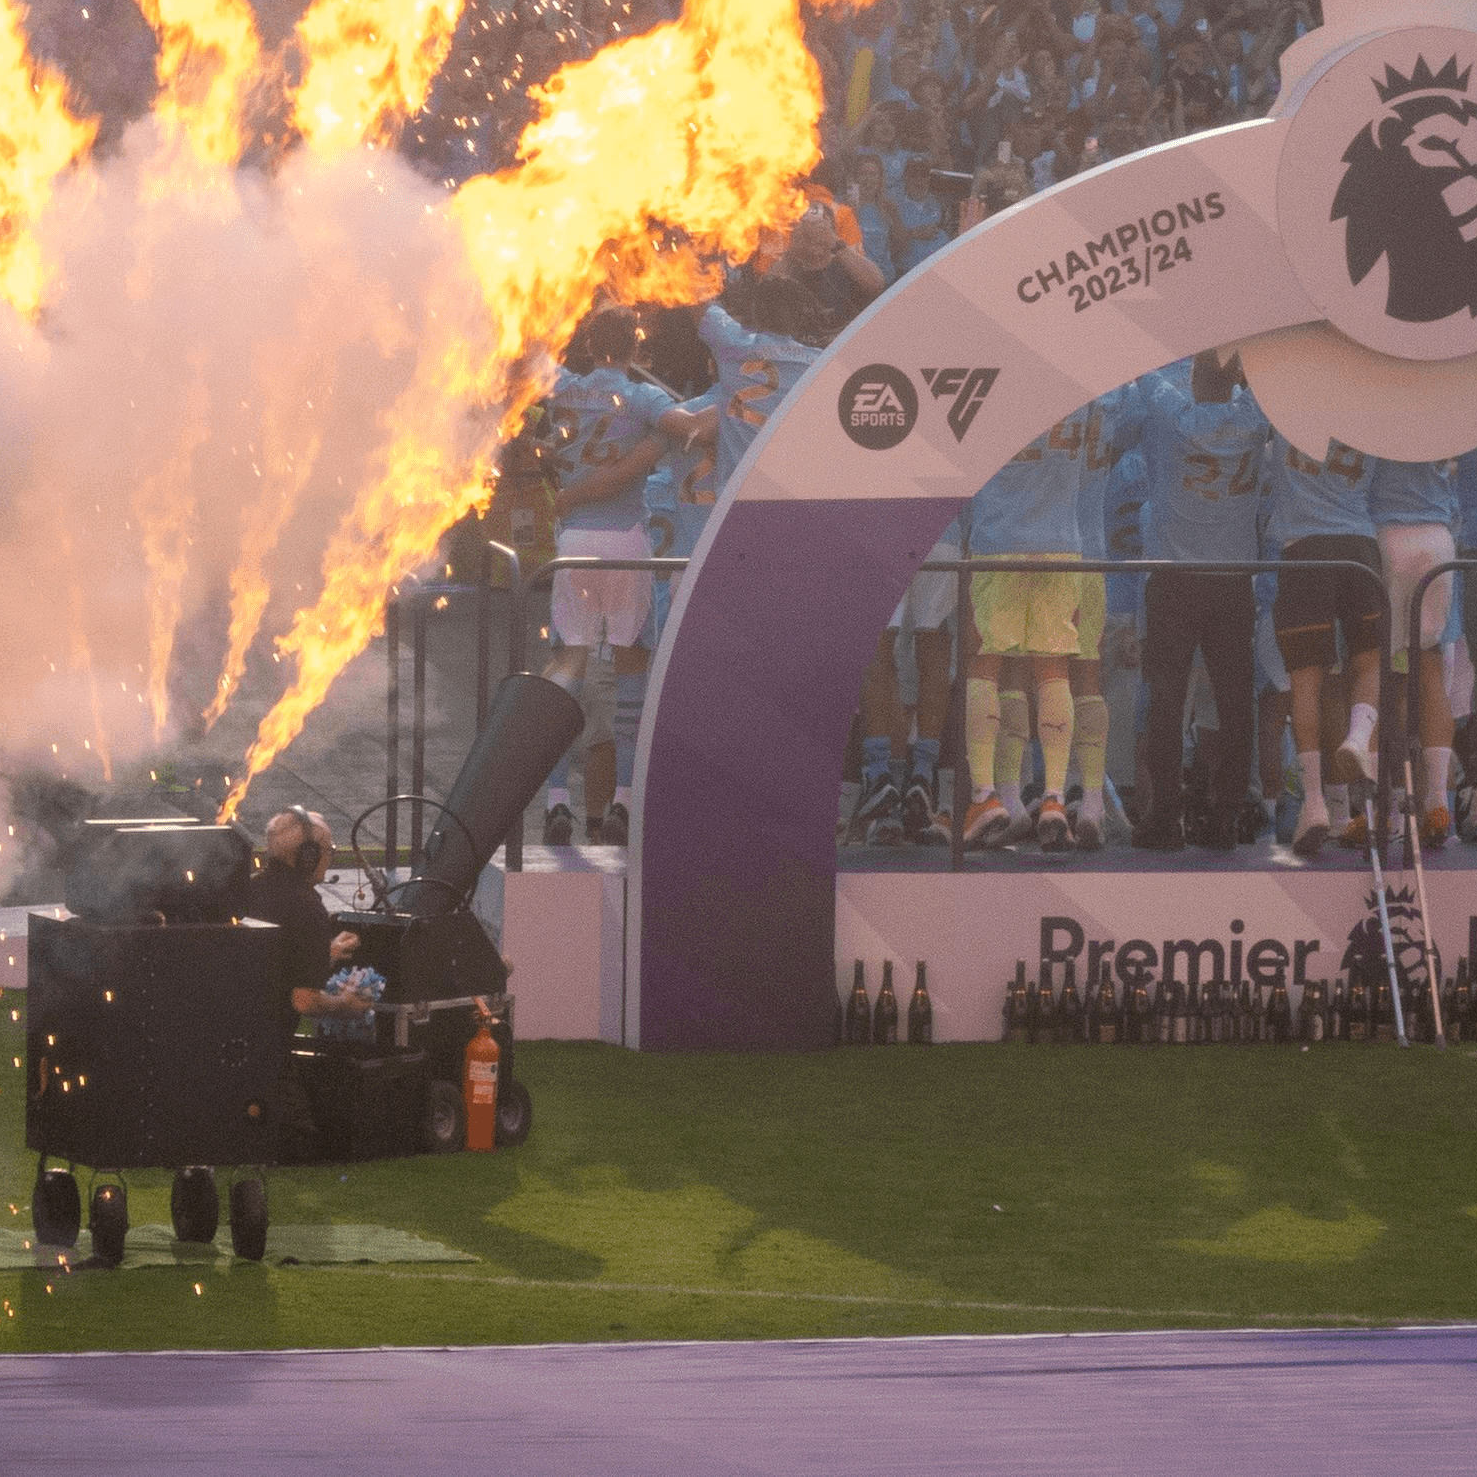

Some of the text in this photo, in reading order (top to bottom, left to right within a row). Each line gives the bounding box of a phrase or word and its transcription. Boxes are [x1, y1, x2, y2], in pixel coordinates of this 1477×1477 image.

[1016, 191, 1227, 305] CHAMPIONS
[1067, 235, 1193, 314] 2023/24
[850, 412, 906, 428] SPORTS
[852, 382, 904, 412] EA
[1040, 915, 1321, 987] Premier
